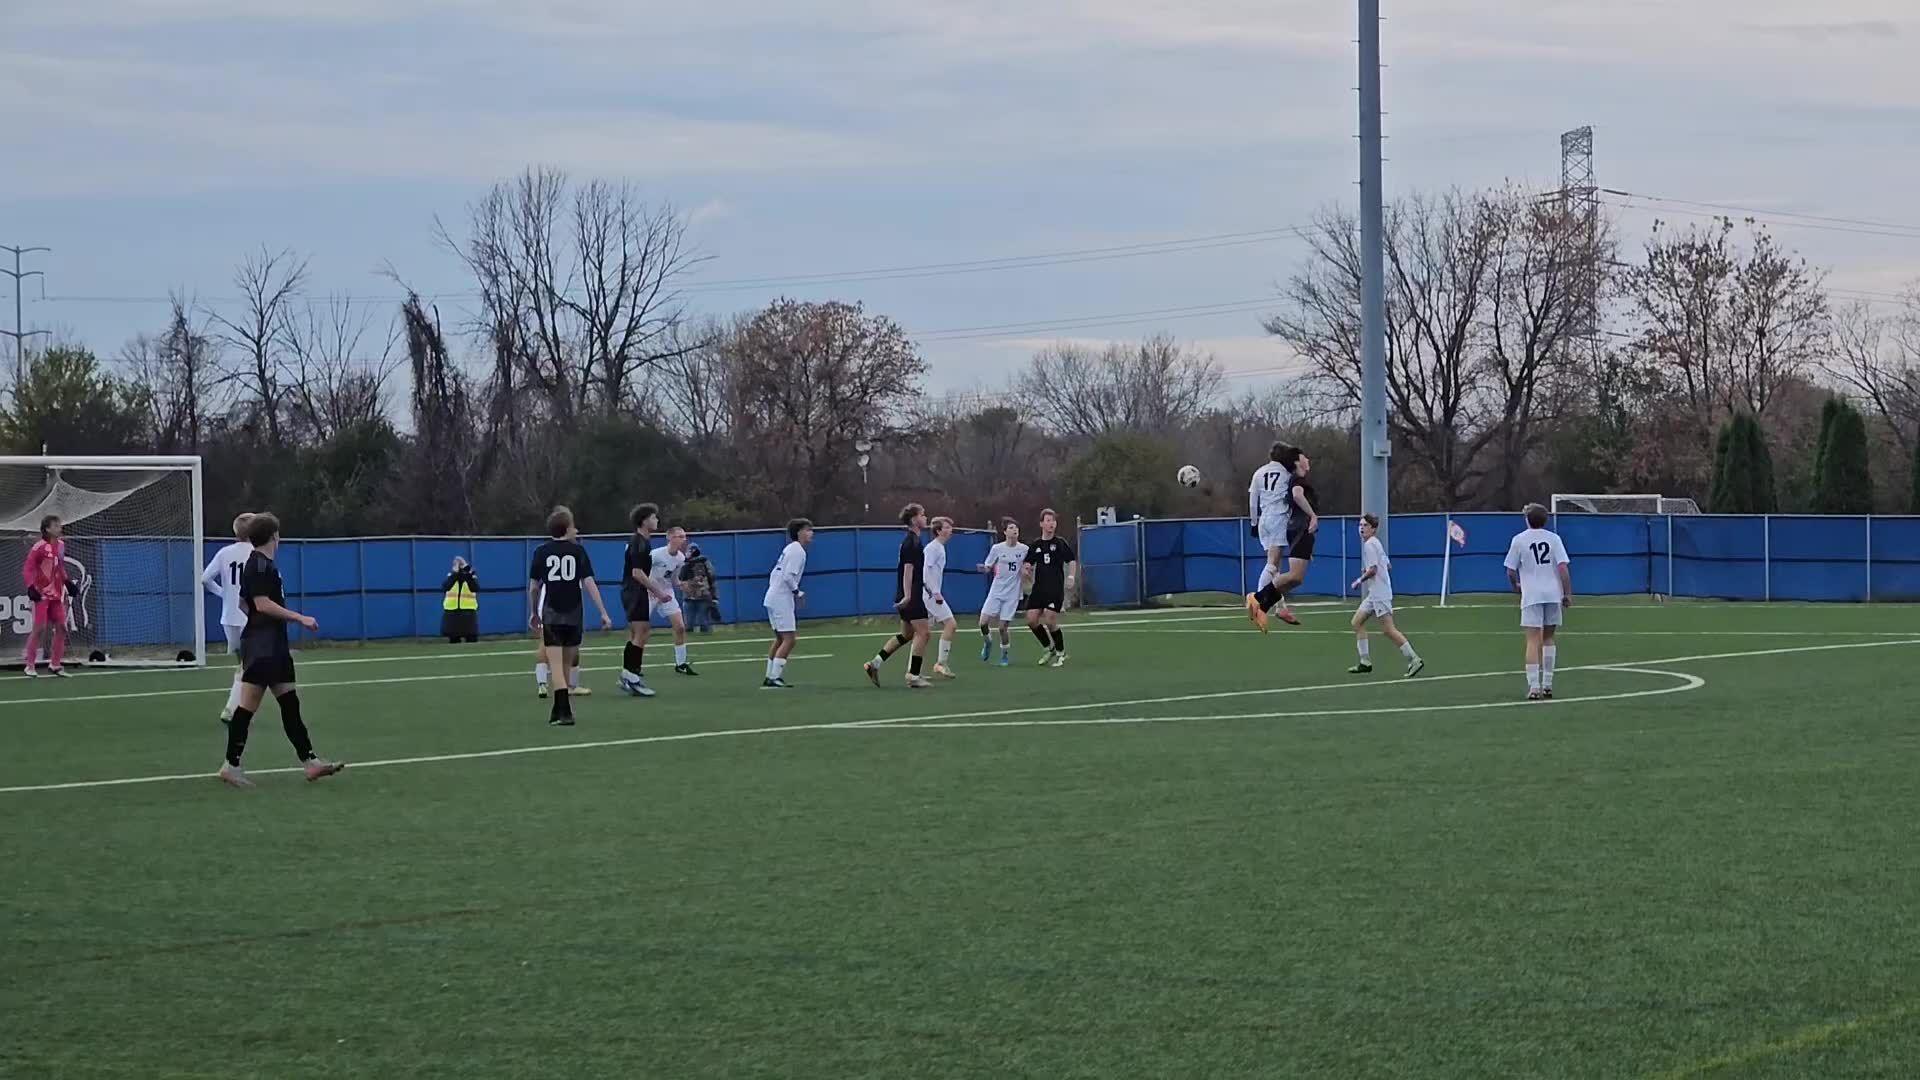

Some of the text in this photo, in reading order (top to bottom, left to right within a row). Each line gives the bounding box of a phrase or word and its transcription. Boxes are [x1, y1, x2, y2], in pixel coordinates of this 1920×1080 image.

[1263, 472, 1280, 491] 17
[1529, 541, 1551, 565] 12
[229, 560, 245, 585] 11
[546, 554, 576, 582] 20
[1007, 561, 1017, 572] 15
